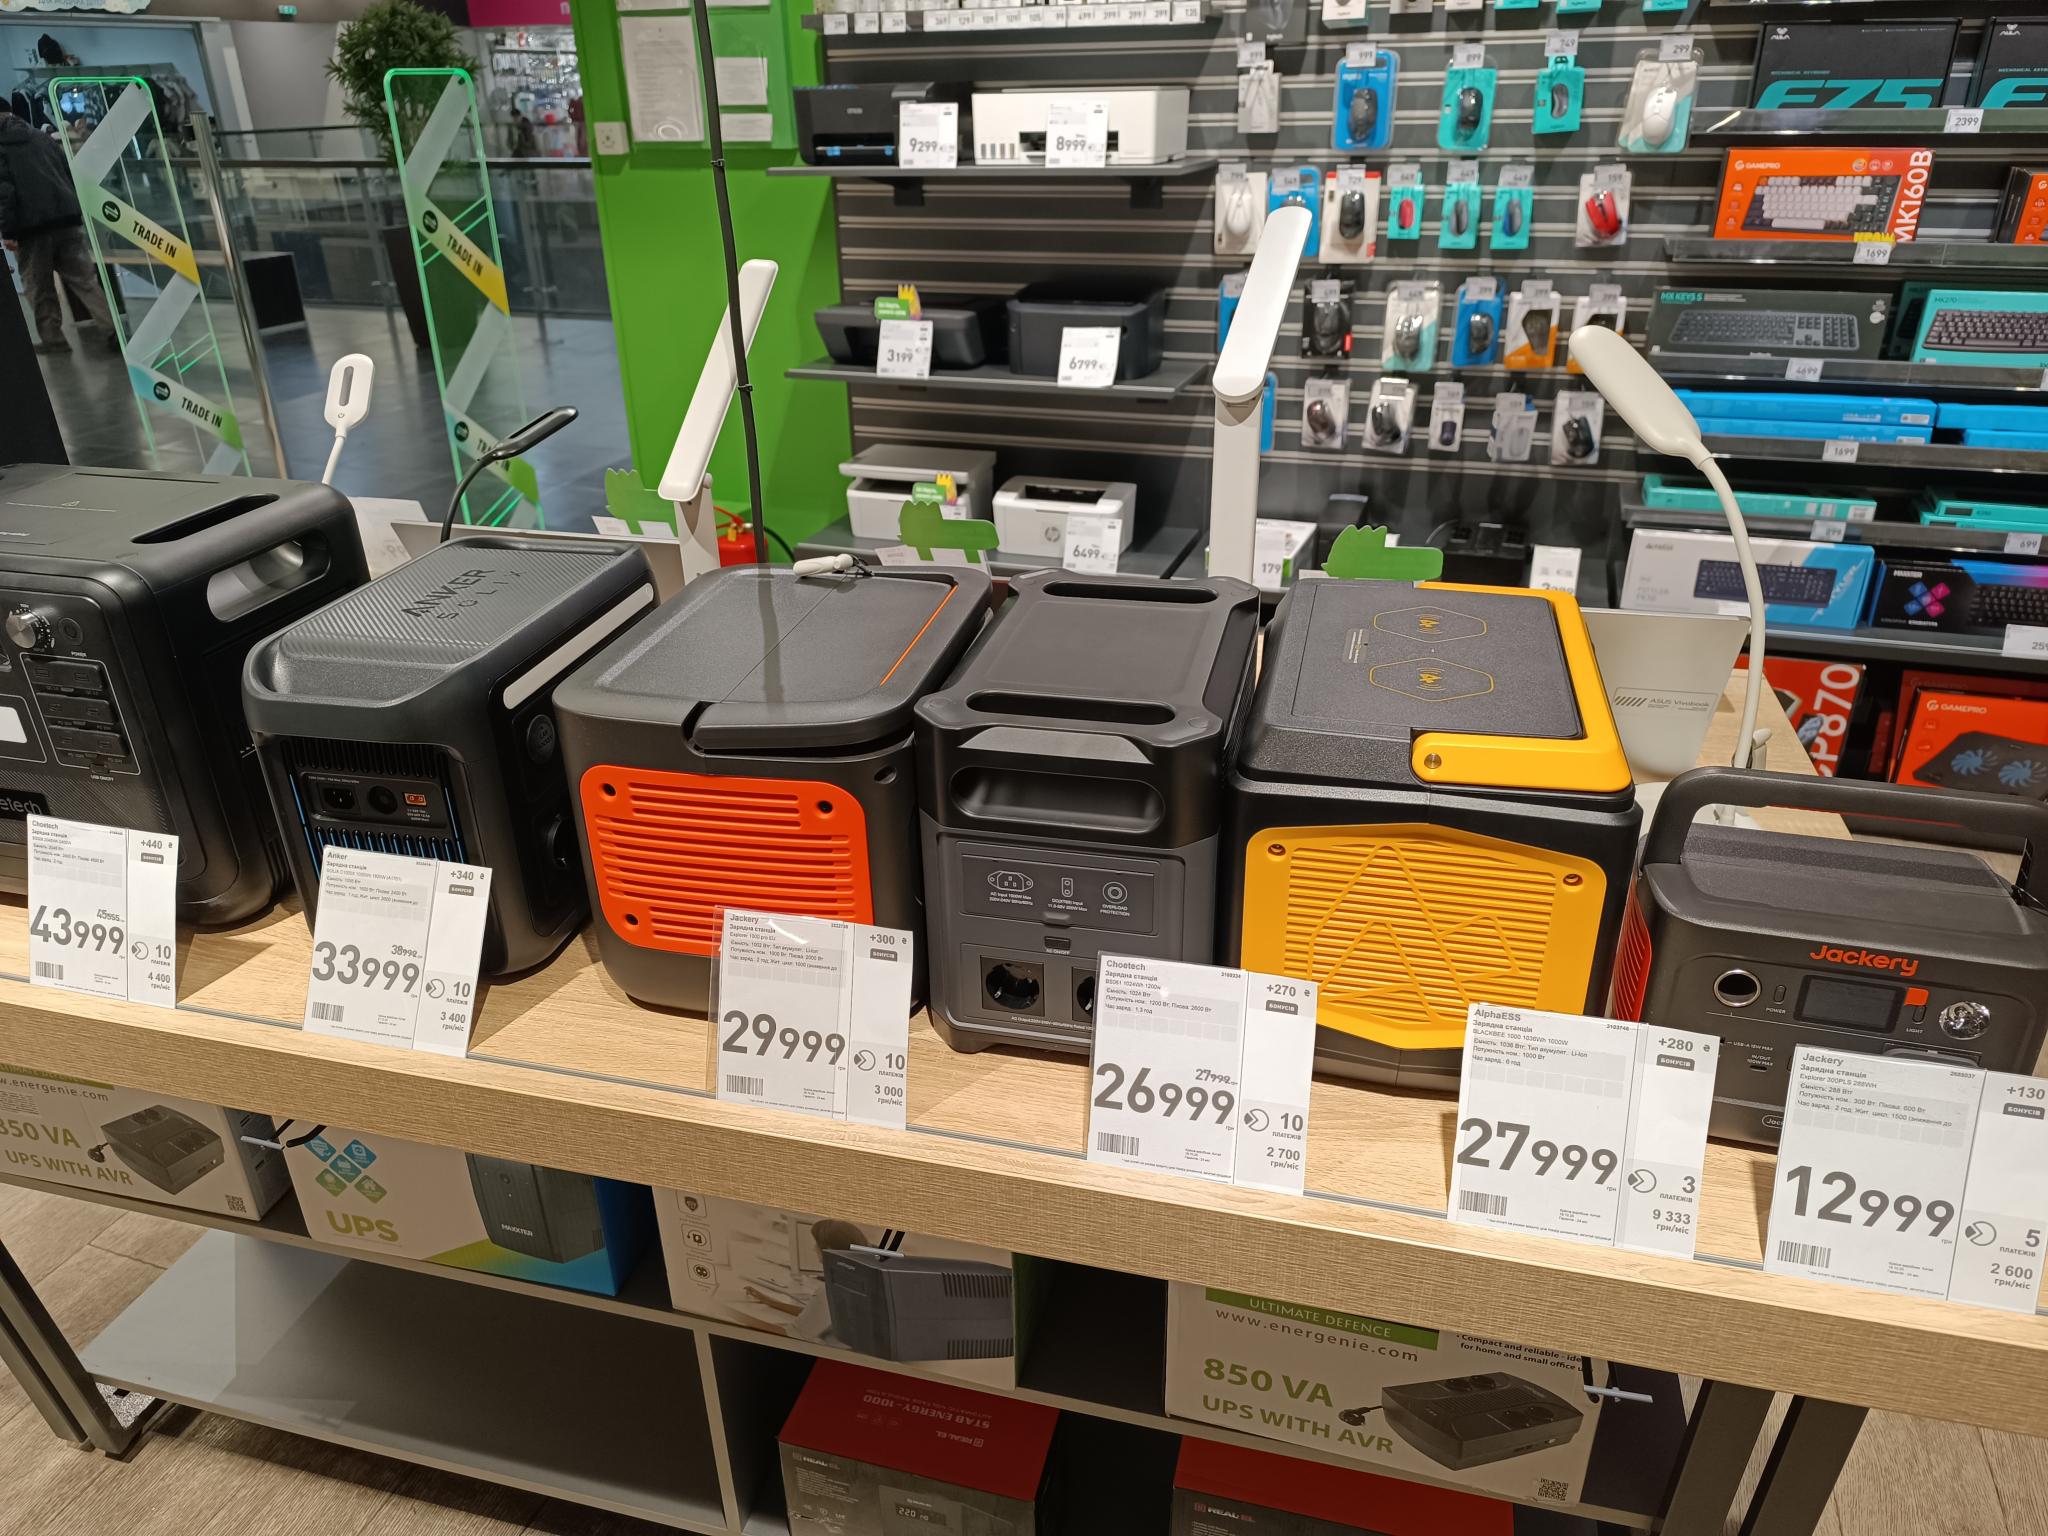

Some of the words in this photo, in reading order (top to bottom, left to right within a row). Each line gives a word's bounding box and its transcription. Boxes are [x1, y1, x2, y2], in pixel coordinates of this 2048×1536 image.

[1672, 44, 1690, 55] 299
[1955, 116, 1979, 127] 2399
[909, 138, 938, 151] 9299
[1056, 136, 1086, 151] 8999
[1746, 162, 1781, 170] GAMEPRO
[1896, 150, 1932, 244] MK160B
[132, 221, 163, 249] TRADE
[165, 242, 177, 259] IN
[446, 234, 473, 269] TRADE
[472, 257, 484, 276] IN
[1865, 248, 1888, 259] 1699
[888, 349, 913, 362] 3199
[1069, 357, 1097, 370] 6799
[181, 397, 210, 421] TRADE
[211, 412, 223, 428] IN
[1835, 448, 1854, 456] 1699
[1073, 544, 1100, 558] 6499
[402, 569, 496, 617] ANKER
[1941, 704, 1988, 714] GAMEPRO
[141, 839, 163, 850] +440
[327, 851, 347, 861] Anker
[450, 870, 474, 881] +340
[730, 913, 759, 925] Jackery
[30, 905, 124, 954] 43999
[730, 924, 754, 932] Зарядна
[870, 933, 895, 945] +300
[156, 944, 172, 959] 10
[312, 941, 420, 993] 33999
[1106, 960, 1146, 971] Choetech
[1809, 945, 1919, 977] Jackery
[148, 971, 154, 981] 4
[155, 972, 171, 983] 400
[1105, 970, 1132, 979] Зарядна
[1134, 974, 1158, 982] станція
[453, 981, 470, 997] 10
[1266, 983, 1296, 997] +270
[1269, 1002, 1295, 1012] БОНУСІВ
[1766, 1007, 1786, 1015] POWER
[440, 1012, 447, 1021] 3
[449, 1013, 466, 1023] 400
[1474, 1008, 1521, 1022] AlphaESS
[1472, 1020, 1504, 1030] Зарядна
[1505, 1024, 1533, 1033] станція
[722, 1009, 846, 1065] 29999
[1473, 1029, 1506, 1038] BLACKBEE
[1548, 1038, 1568, 1046] 1000W
[1658, 1036, 1693, 1051] +280
[1528, 1044, 1539, 1052] Тип
[885, 1053, 905, 1070] 10
[1523, 1052, 1537, 1060] 1000
[1660, 1057, 1691, 1068] БОНУСІВ
[1803, 1053, 1844, 1066] Jackery
[1800, 1064, 1834, 1075] Зарядна
[1836, 1069, 1867, 1078] станція
[1800, 1073, 1825, 1083] Explorer
[875, 1085, 881, 1095] 3
[884, 1086, 903, 1097] 000
[1094, 1062, 1235, 1125] 26999
[2007, 1086, 2046, 1100] +130
[877, 1097, 903, 1106] грн/міс
[2008, 1106, 2041, 1117] БОНУСІВ
[1280, 1112, 1303, 1132] 10
[41, 1124, 81, 1149] VA
[1272, 1131, 1301, 1140] ПЛАТЕЖІВ
[1266, 1146, 1274, 1158] 2
[1279, 1148, 1301, 1161] 700
[1457, 1117, 1618, 1185] 27999
[5, 1150, 42, 1168] UPS
[43, 1157, 92, 1177] WITH
[97, 1167, 134, 1185] AVR
[1270, 1160, 1299, 1171] грн/міс
[1682, 1175, 1696, 1194] 3
[1660, 1193, 1693, 1203] ПЛАТЕЖІВ
[1787, 1165, 1954, 1237] 12999
[1652, 1208, 1661, 1220] 9
[1665, 1210, 1691, 1225] 333
[325, 1209, 399, 1242] UPS
[1656, 1223, 1689, 1235] грн/міс
[2025, 1228, 2041, 1248] 5
[1999, 1246, 2036, 1257] ПЛАТЕЖІВ
[1990, 1263, 1999, 1275] 2
[2005, 1265, 2033, 1280] 600
[1994, 1278, 2031, 1290] грн/міс
[1249, 1297, 1321, 1323] ULTIMATE
[1324, 1312, 1392, 1339] DEFENCE
[1215, 1308, 1419, 1364] www.energenie.com
[1461, 1334, 1502, 1347] Compact
[1524, 1347, 1559, 1359] reliable
[1460, 1342, 1473, 1350] for
[1476, 1346, 1502, 1356] home
[1504, 1352, 1521, 1360] and
[1523, 1355, 1548, 1365] small
[1550, 1361, 1579, 1370] office
[1203, 1358, 1273, 1392] 850
[1282, 1375, 1334, 1408] VA
[863, 1394, 895, 1407] 1000
[903, 1404, 953, 1421] ENERGY
[1202, 1395, 1254, 1421] UPS
[1257, 1405, 1331, 1439] WITH
[1337, 1429, 1394, 1454] AVR
